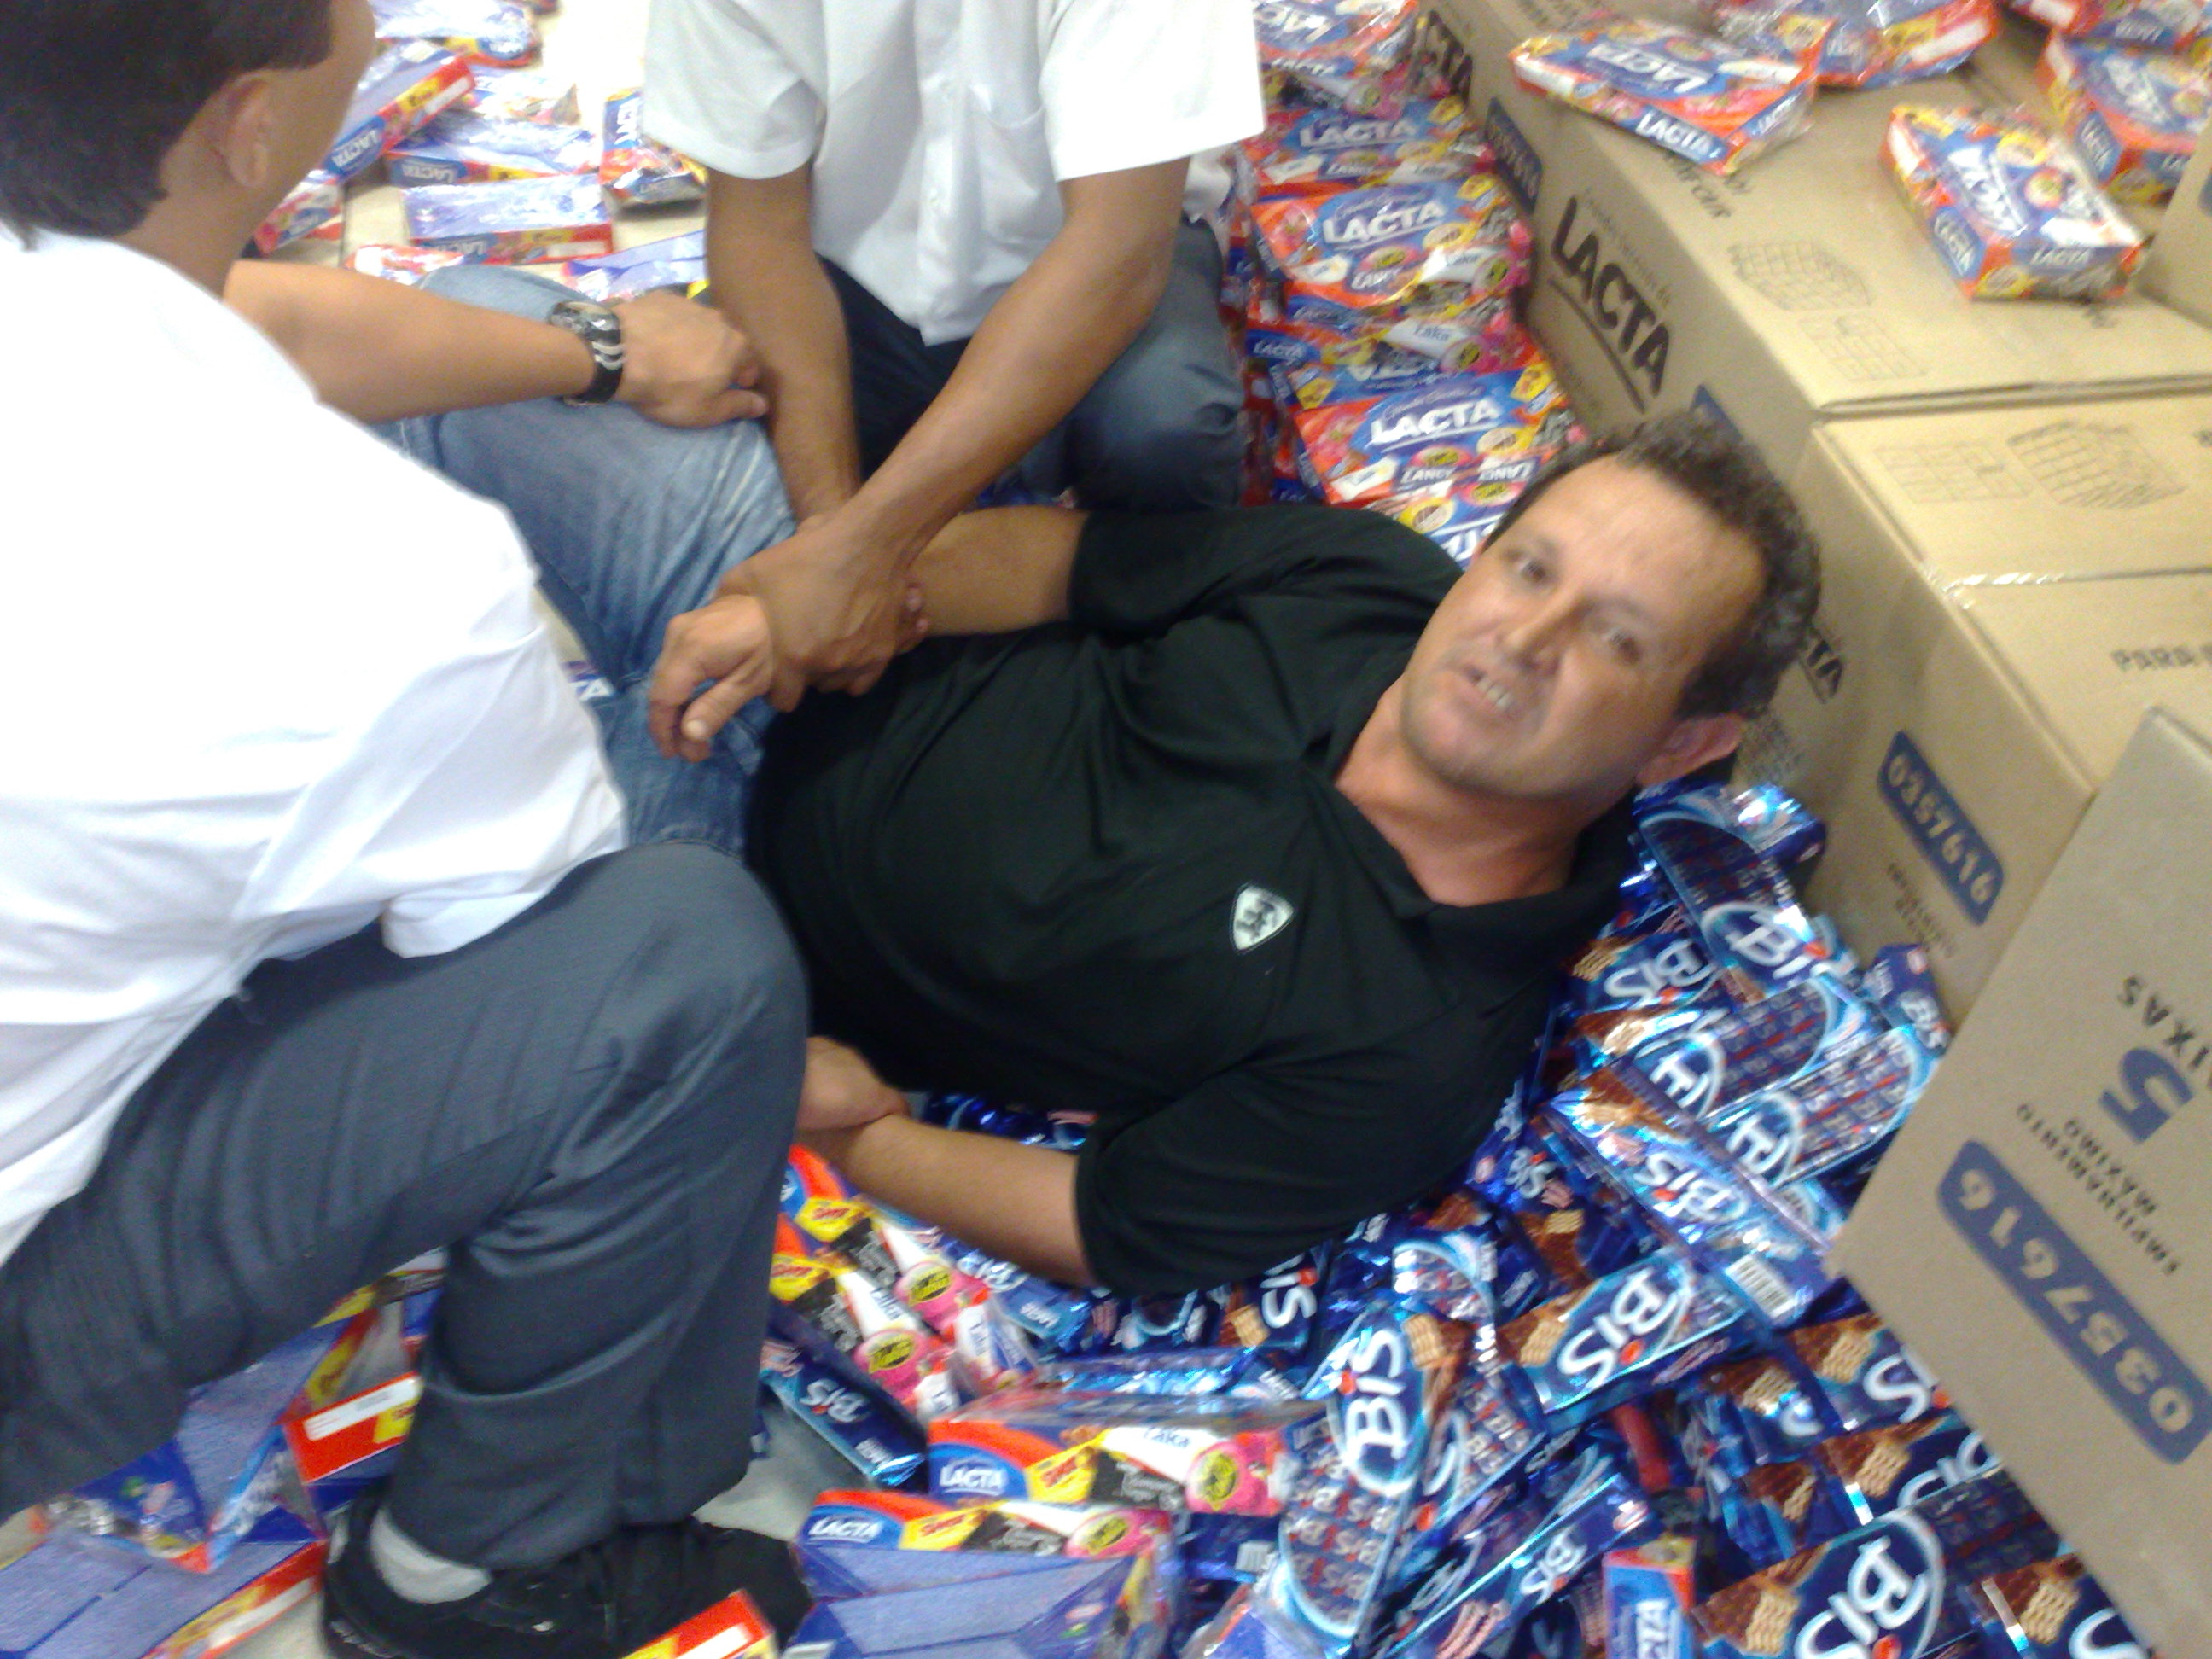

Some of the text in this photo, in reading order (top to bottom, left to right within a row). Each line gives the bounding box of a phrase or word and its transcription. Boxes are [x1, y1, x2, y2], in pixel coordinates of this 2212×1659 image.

[1299, 120, 1417, 148] LACTA
[1323, 201, 1446, 244] LACTA
[1551, 195, 1670, 398] LACTA
[1371, 396, 1505, 446] LACTA
[2117, 976, 2212, 1088] IXAS
[2098, 1047, 2194, 1144] 5
[1957, 1167, 2195, 1434] 0357616
[940, 1464, 1006, 1490] LACTA
[809, 1517, 884, 1541] LACTA
